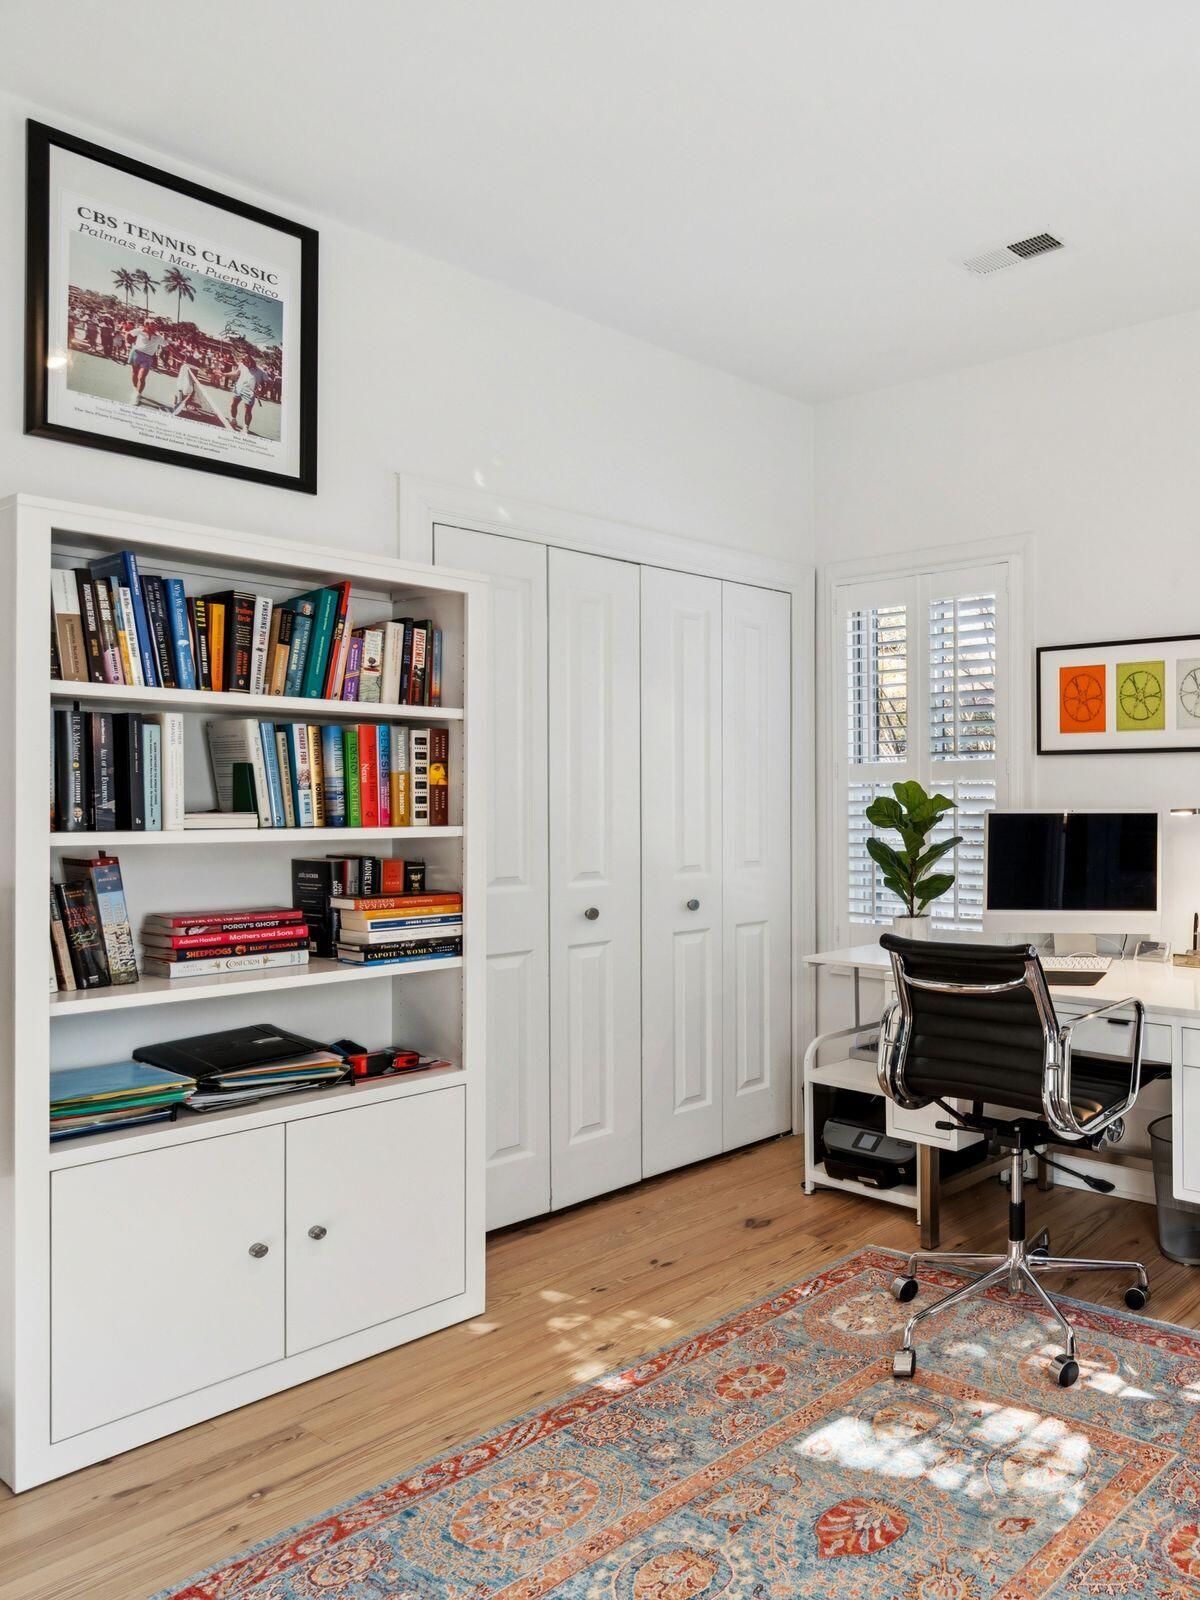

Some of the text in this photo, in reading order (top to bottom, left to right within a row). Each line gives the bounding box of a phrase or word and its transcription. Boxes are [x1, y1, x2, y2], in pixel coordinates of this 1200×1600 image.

[77, 206, 279, 285] CBS TENNIS CLASSIC
[78, 223, 278, 299] Palmas del Mar, Puerto Rico
[172, 584, 185, 636] Why We Remember
[261, 601, 269, 630] PUNISHING
[156, 622, 169, 677] CHRIS WHITAKER
[416, 630, 424, 666] APPEASEMENT
[72, 733, 81, 761] McMaster
[298, 728, 307, 750] RICHARD
[350, 743, 358, 774] TOLSTOY
[381, 730, 389, 779] GENESIS
[361, 763, 369, 783] Nexus
[364, 860, 372, 884] MONEY
[358, 902, 395, 910] KAFKAS
[222, 920, 279, 931] PORGY'S GHOST
[229, 933, 261, 941] Mothers
[186, 948, 232, 959] SHEEPDOGS
[225, 958, 261, 969] CONFORM
[368, 951, 404, 959] CAPOTE'S
